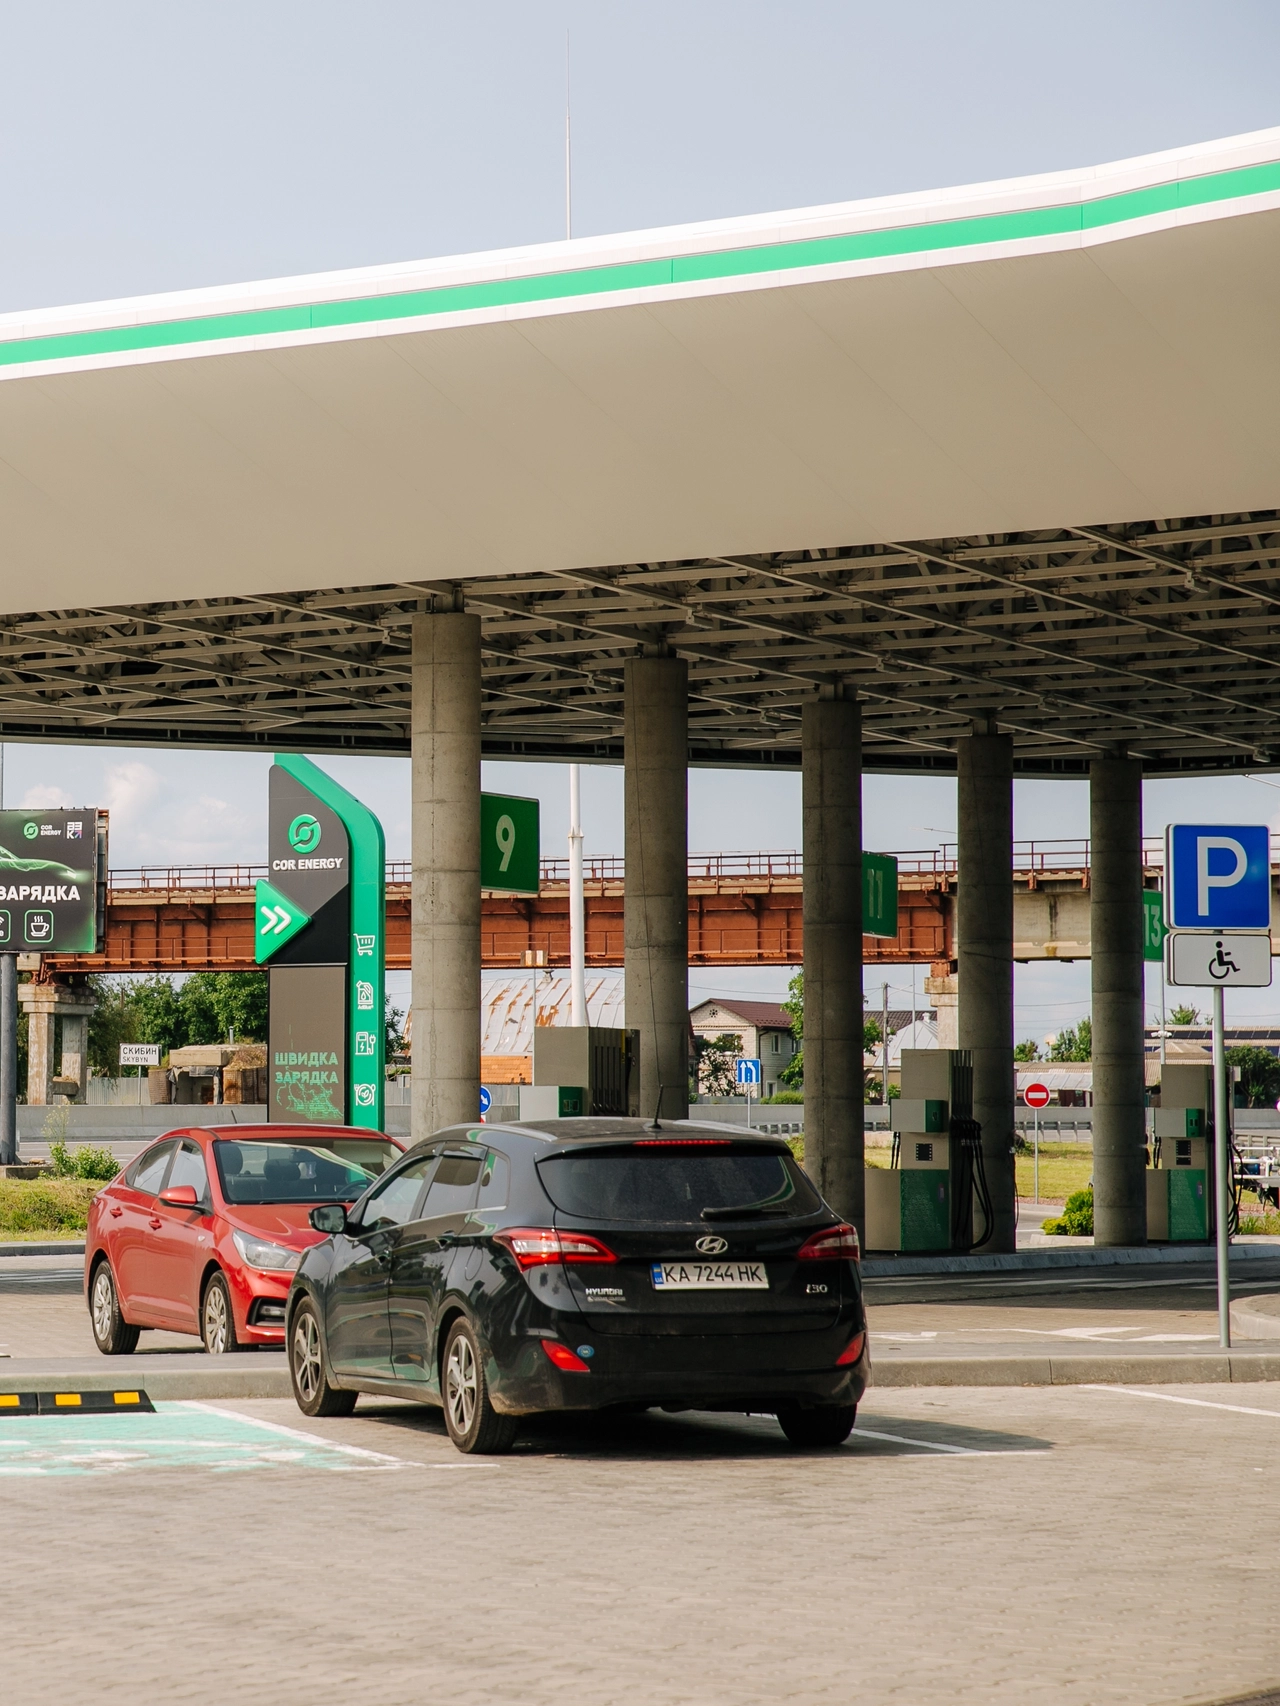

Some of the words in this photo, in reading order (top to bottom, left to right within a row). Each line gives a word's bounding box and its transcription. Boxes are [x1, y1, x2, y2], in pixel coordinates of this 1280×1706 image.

[496, 814, 516, 872] 9
[272, 859, 297, 871] COR
[298, 857, 344, 870] ENERGY
[1197, 836, 1248, 916] P
[867, 868, 883, 919] 11
[1143, 903, 1162, 948] 13
[122, 1046, 157, 1055] СКИБИН
[274, 1051, 339, 1067] ШВИДКА
[274, 1071, 339, 1085] ЗАРЯДКА
[663, 1265, 691, 1283] KA
[693, 1265, 735, 1282] 7244
[737, 1265, 764, 1282] HK
[585, 1287, 624, 1296] HYUNDAI
